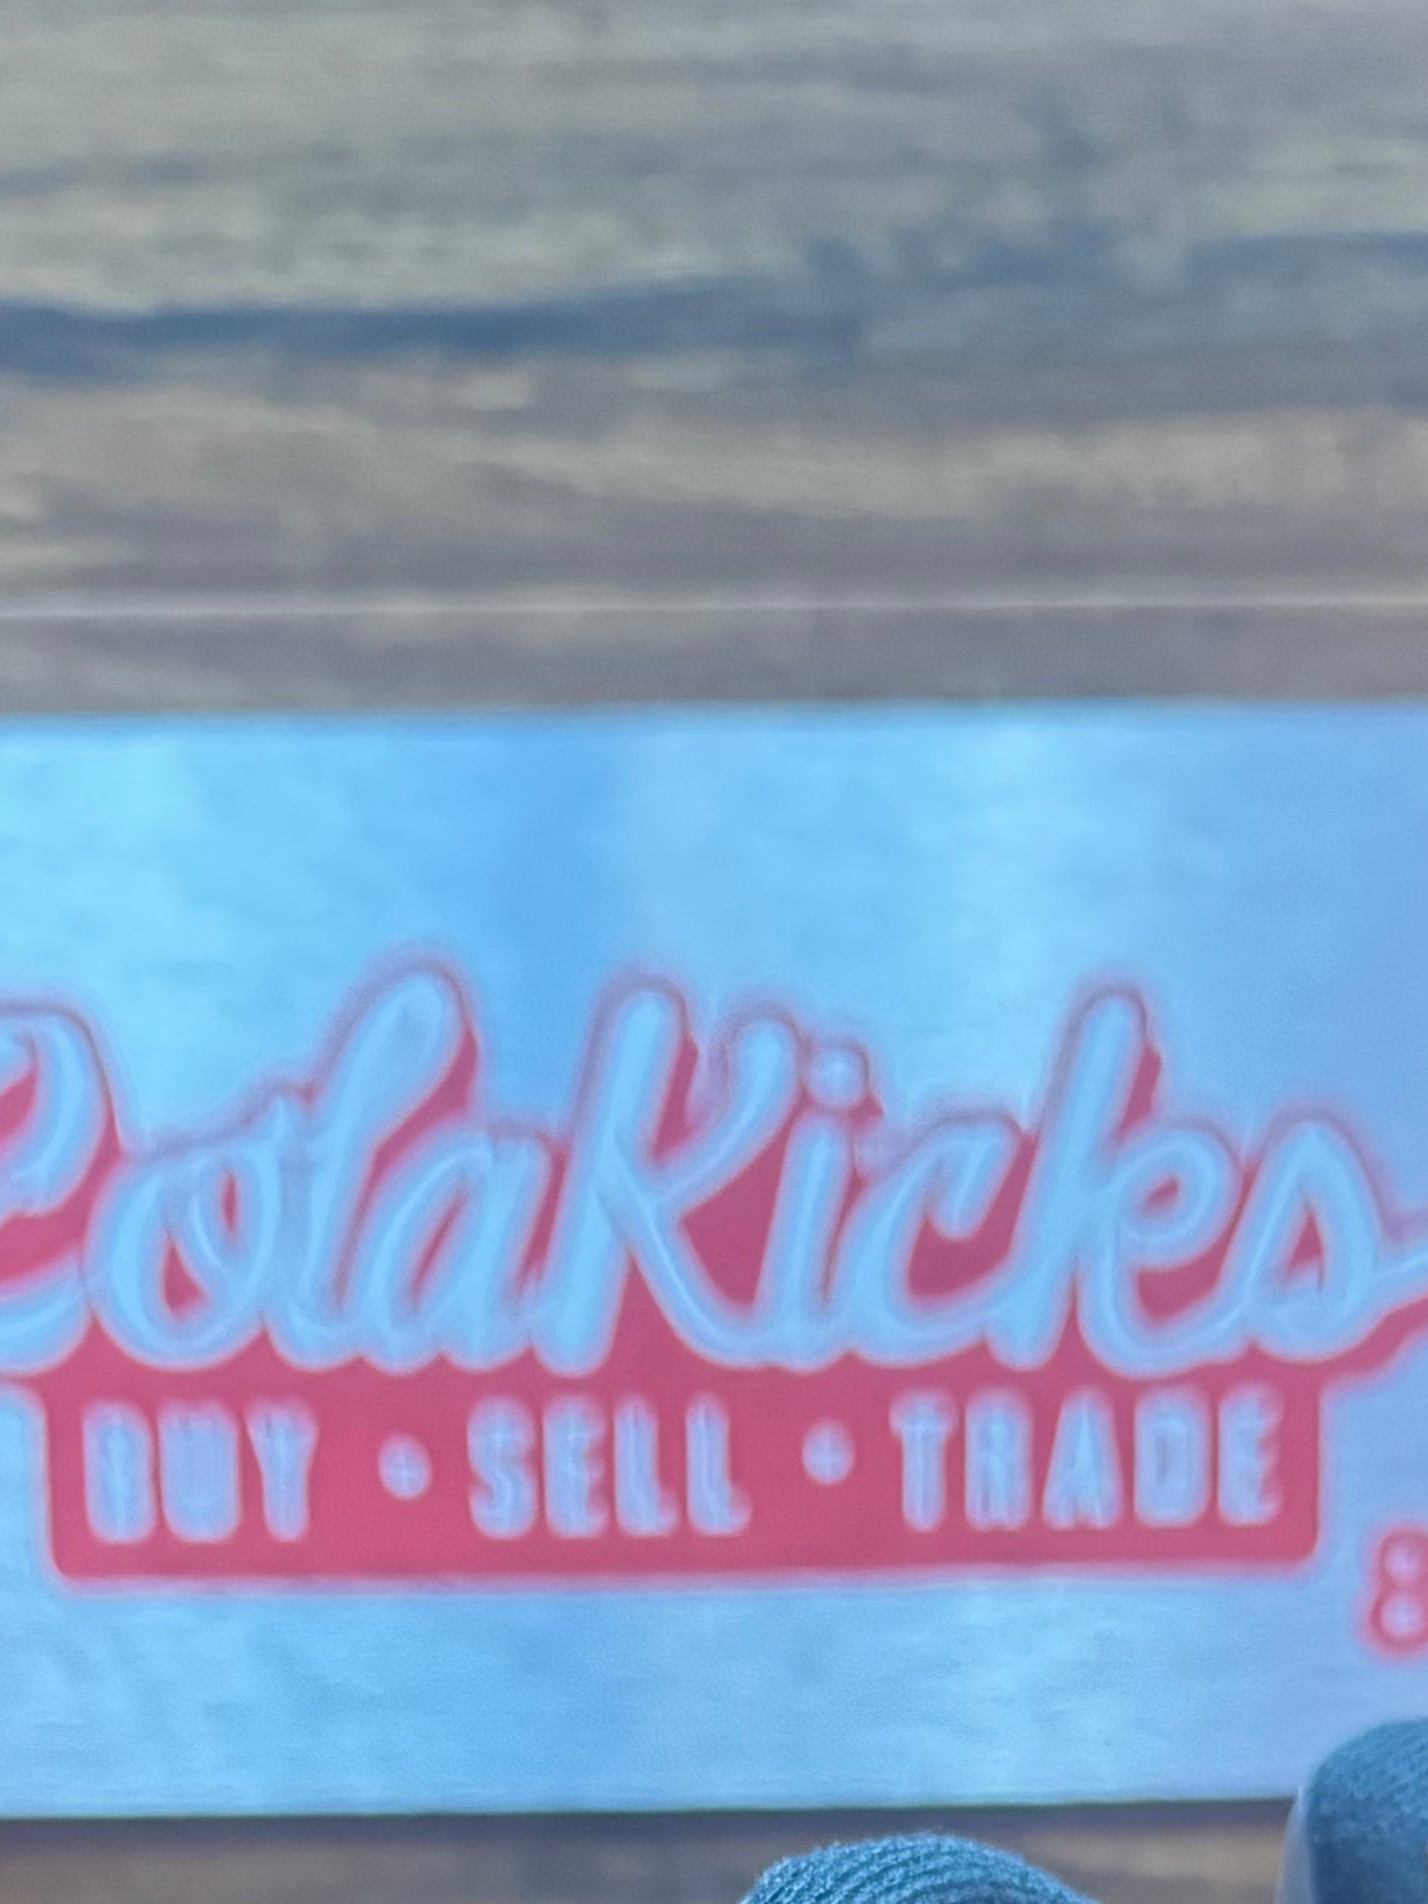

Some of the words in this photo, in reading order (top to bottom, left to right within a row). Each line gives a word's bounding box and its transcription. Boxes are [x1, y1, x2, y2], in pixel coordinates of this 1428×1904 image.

[81, 1398, 318, 1545] BUY
[466, 1392, 750, 1541] SELL
[890, 1387, 1282, 1533] TRADE
